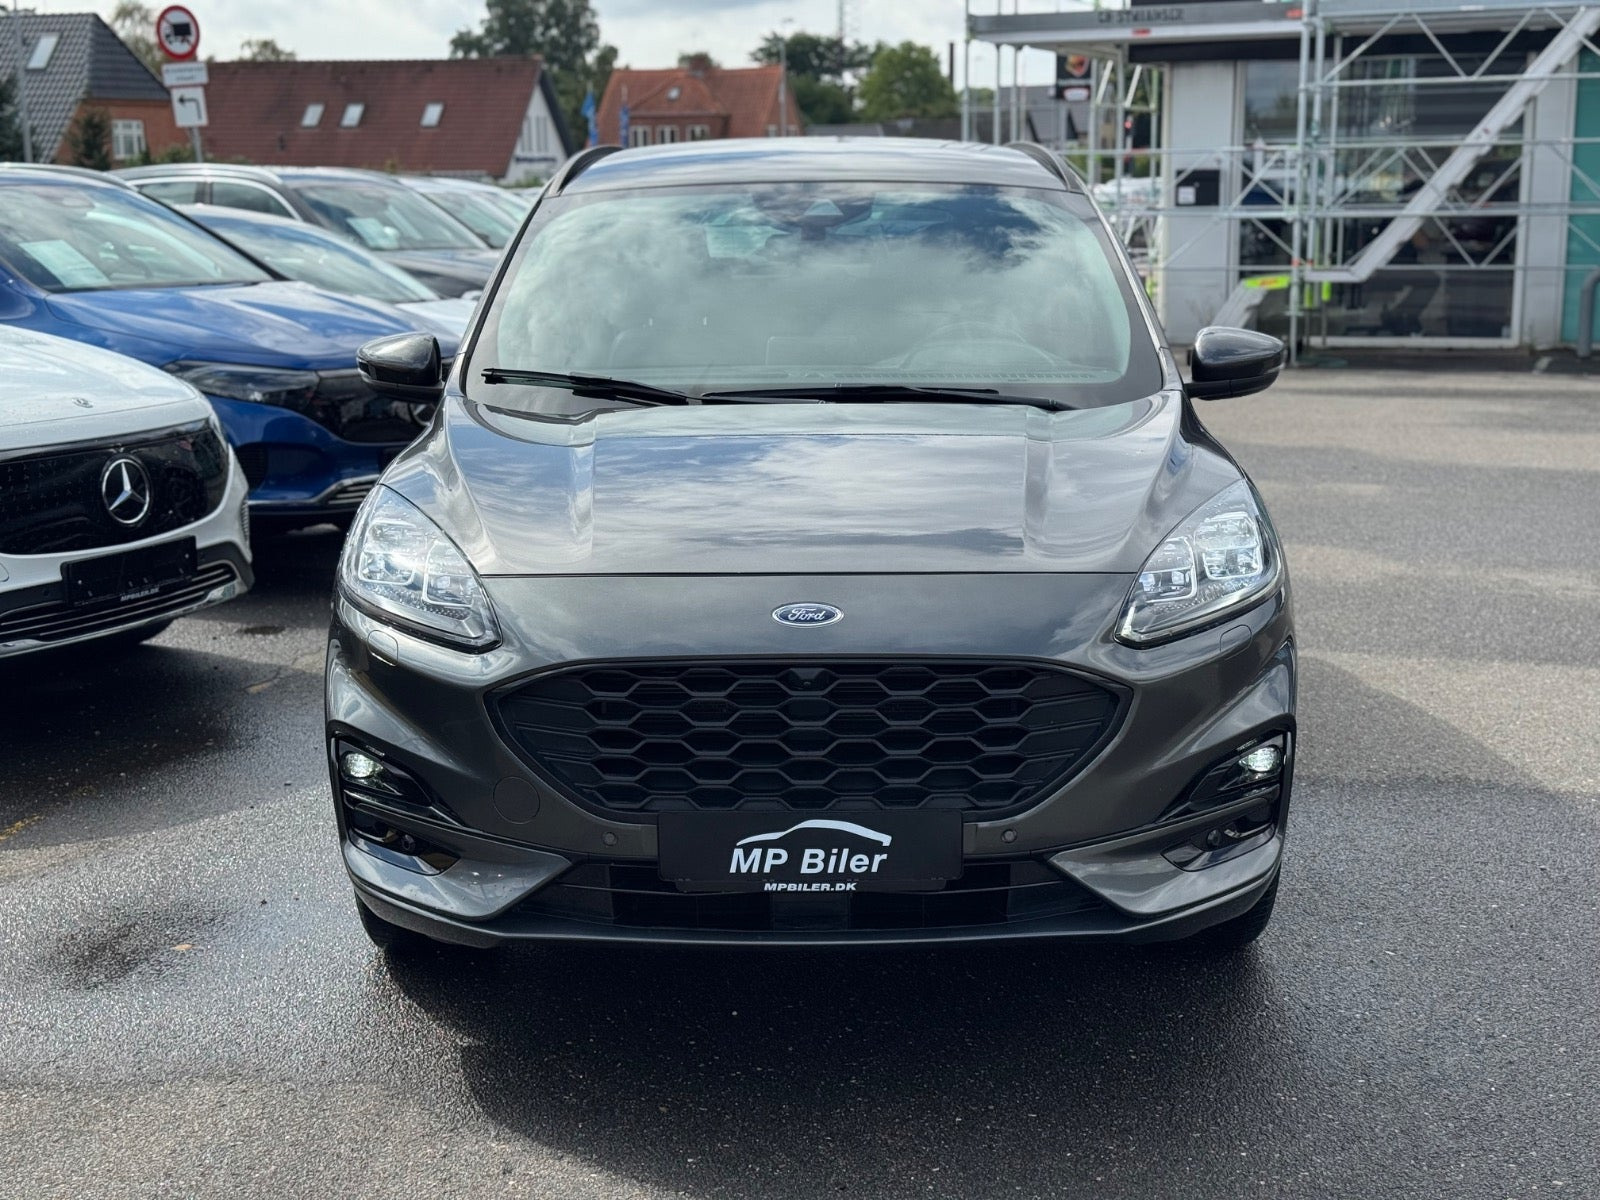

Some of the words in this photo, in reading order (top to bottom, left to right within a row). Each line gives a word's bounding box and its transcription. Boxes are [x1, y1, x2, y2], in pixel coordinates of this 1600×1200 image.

[788, 607, 826, 621] Ford
[729, 848, 789, 873] MP
[800, 848, 888, 874] Biler
[764, 882, 858, 892] MPBILER.DK
